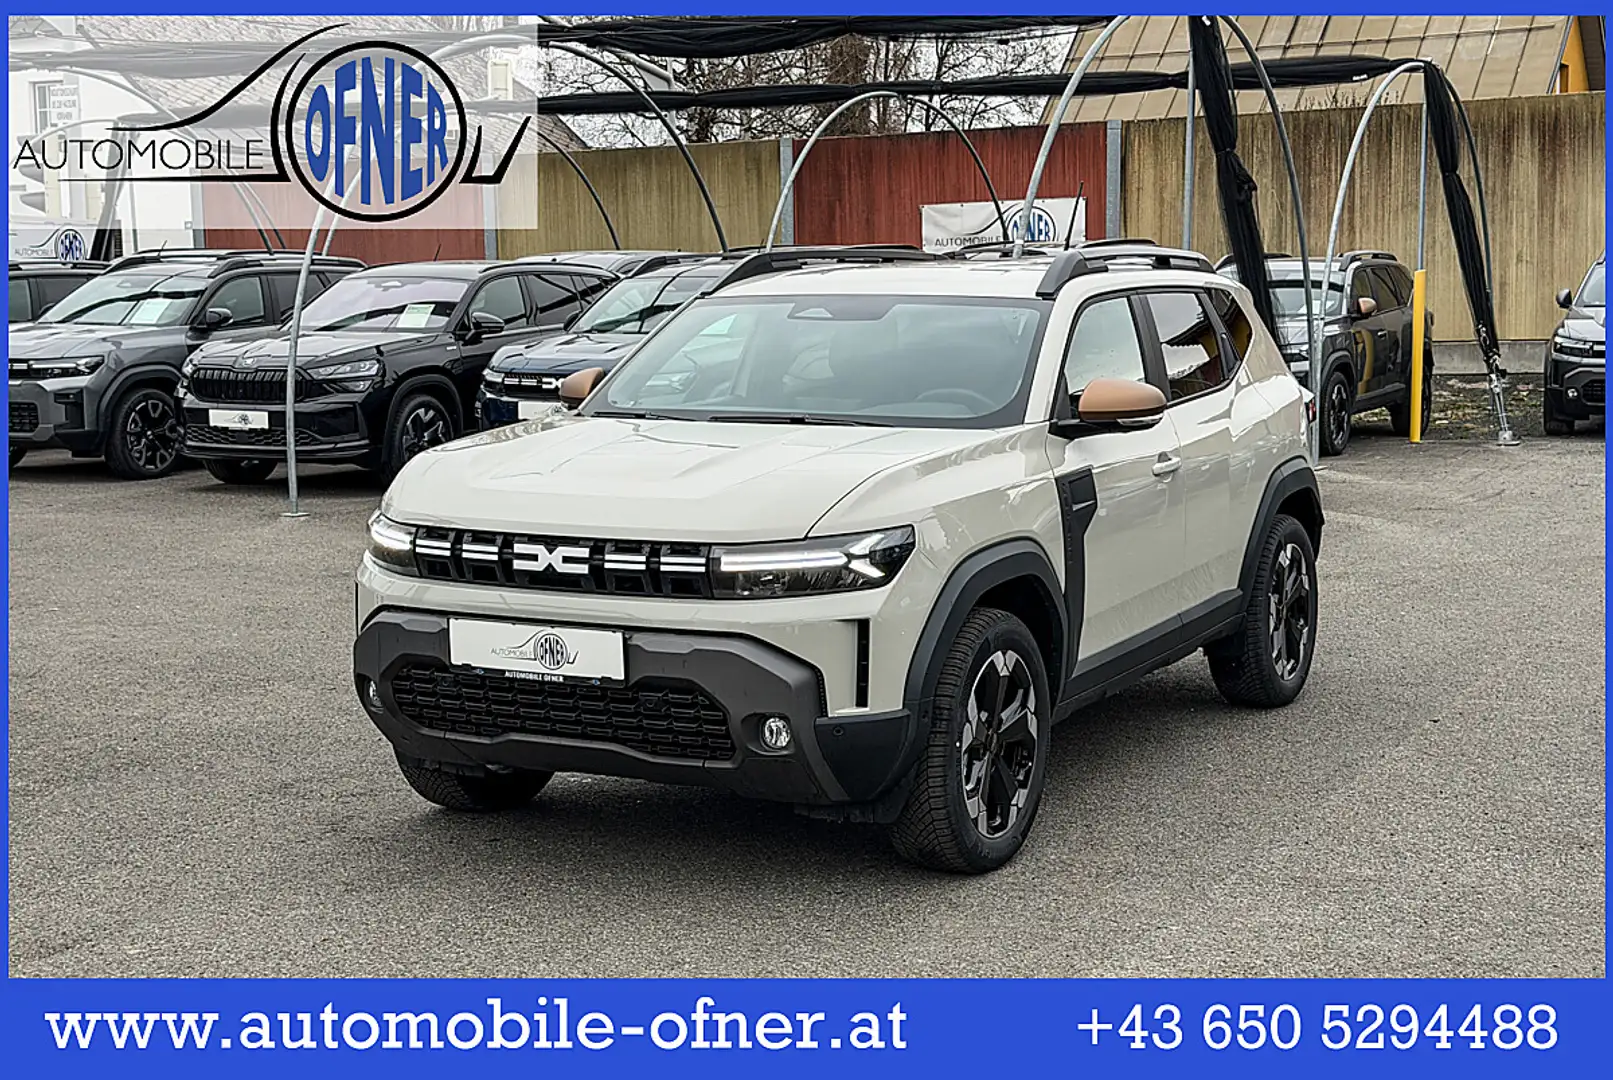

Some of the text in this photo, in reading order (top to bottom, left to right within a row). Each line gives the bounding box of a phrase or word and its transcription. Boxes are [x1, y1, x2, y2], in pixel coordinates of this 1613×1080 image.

[490, 636, 564, 667] AUTOMOBILE OFNER
[504, 670, 564, 682] AUTOMOBILE OFNER
